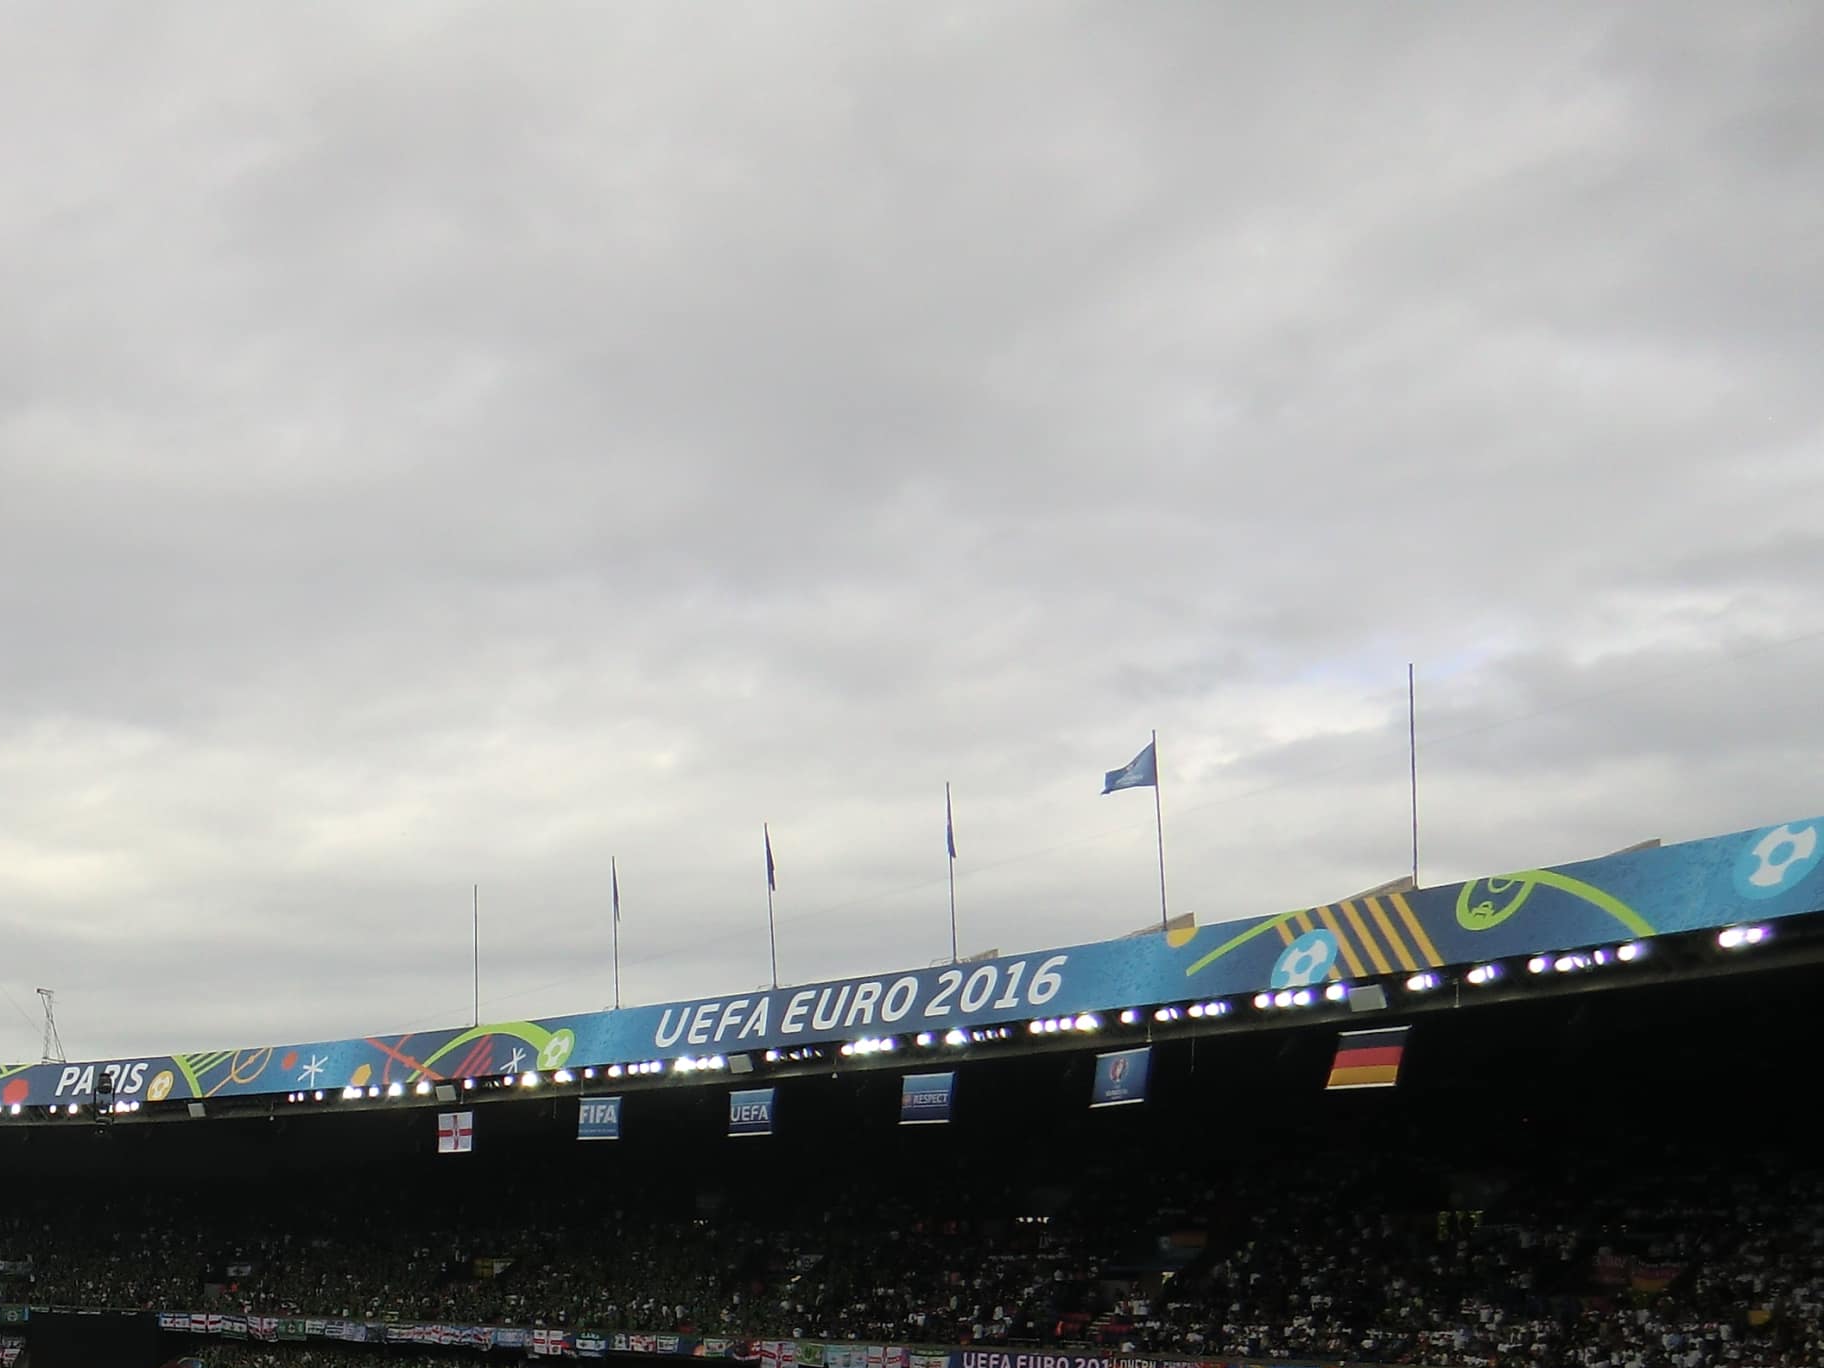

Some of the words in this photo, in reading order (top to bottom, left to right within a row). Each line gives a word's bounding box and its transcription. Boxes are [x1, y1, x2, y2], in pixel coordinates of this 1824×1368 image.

[654, 996, 768, 1048] UEFA
[780, 975, 919, 1034] EURO
[923, 955, 1068, 1018] 2016
[912, 1093, 949, 1107] RESPECT
[579, 1104, 617, 1124] FIFA
[730, 1104, 769, 1122] UEFA
